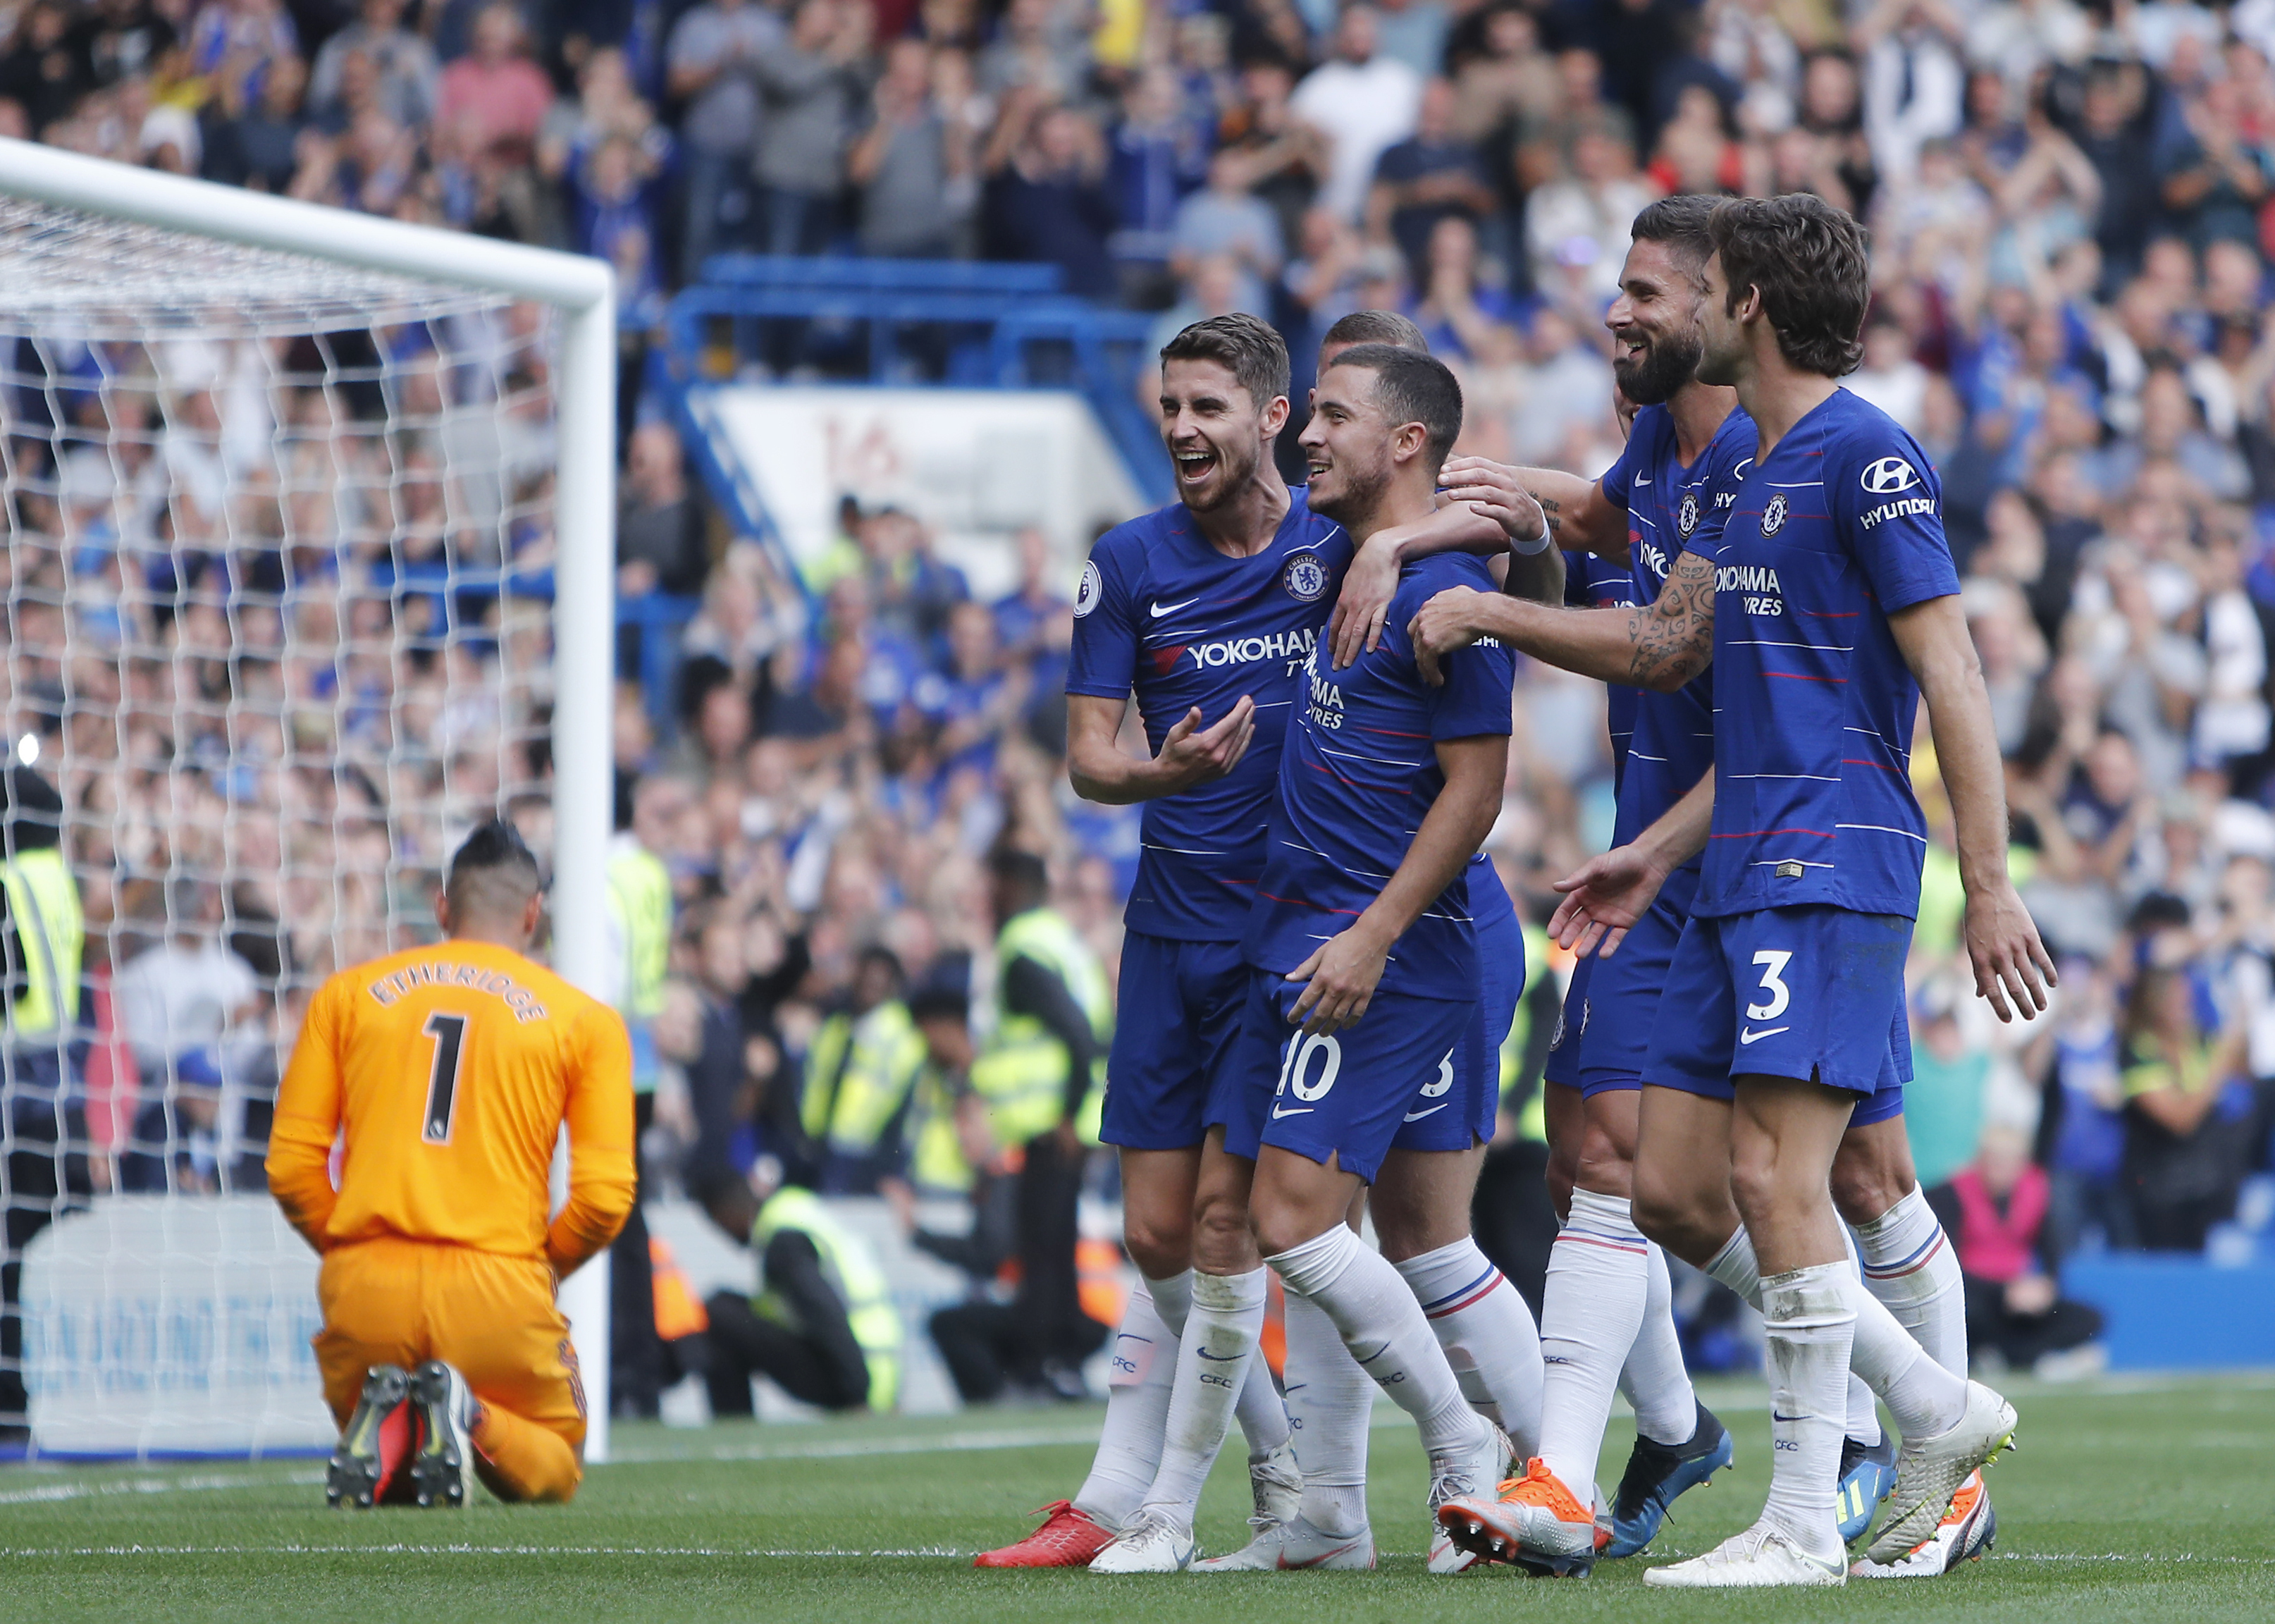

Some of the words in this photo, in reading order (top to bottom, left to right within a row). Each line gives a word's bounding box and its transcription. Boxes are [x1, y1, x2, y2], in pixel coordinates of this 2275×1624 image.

[1860, 498, 1935, 529] HYUNDAI
[1288, 556, 1318, 570] CHELSEA
[1714, 566, 1782, 594] OKOHAMA
[1743, 597, 1783, 616] YRES
[1187, 626, 1326, 669] YOKOHAM
[1306, 701, 1345, 730] YRES
[367, 963, 548, 1023] ETHERIDGE
[1746, 950, 1793, 1020] 3
[421, 1011, 467, 1145] 1
[1276, 1028, 1341, 1102] 10
[1113, 1356, 1136, 1373] CFC
[1543, 1355, 1569, 1365] CFC
[1200, 1374, 1233, 1389] CFC
[1289, 1418, 1303, 1429] FC
[1775, 1439, 1799, 1451] CFC
